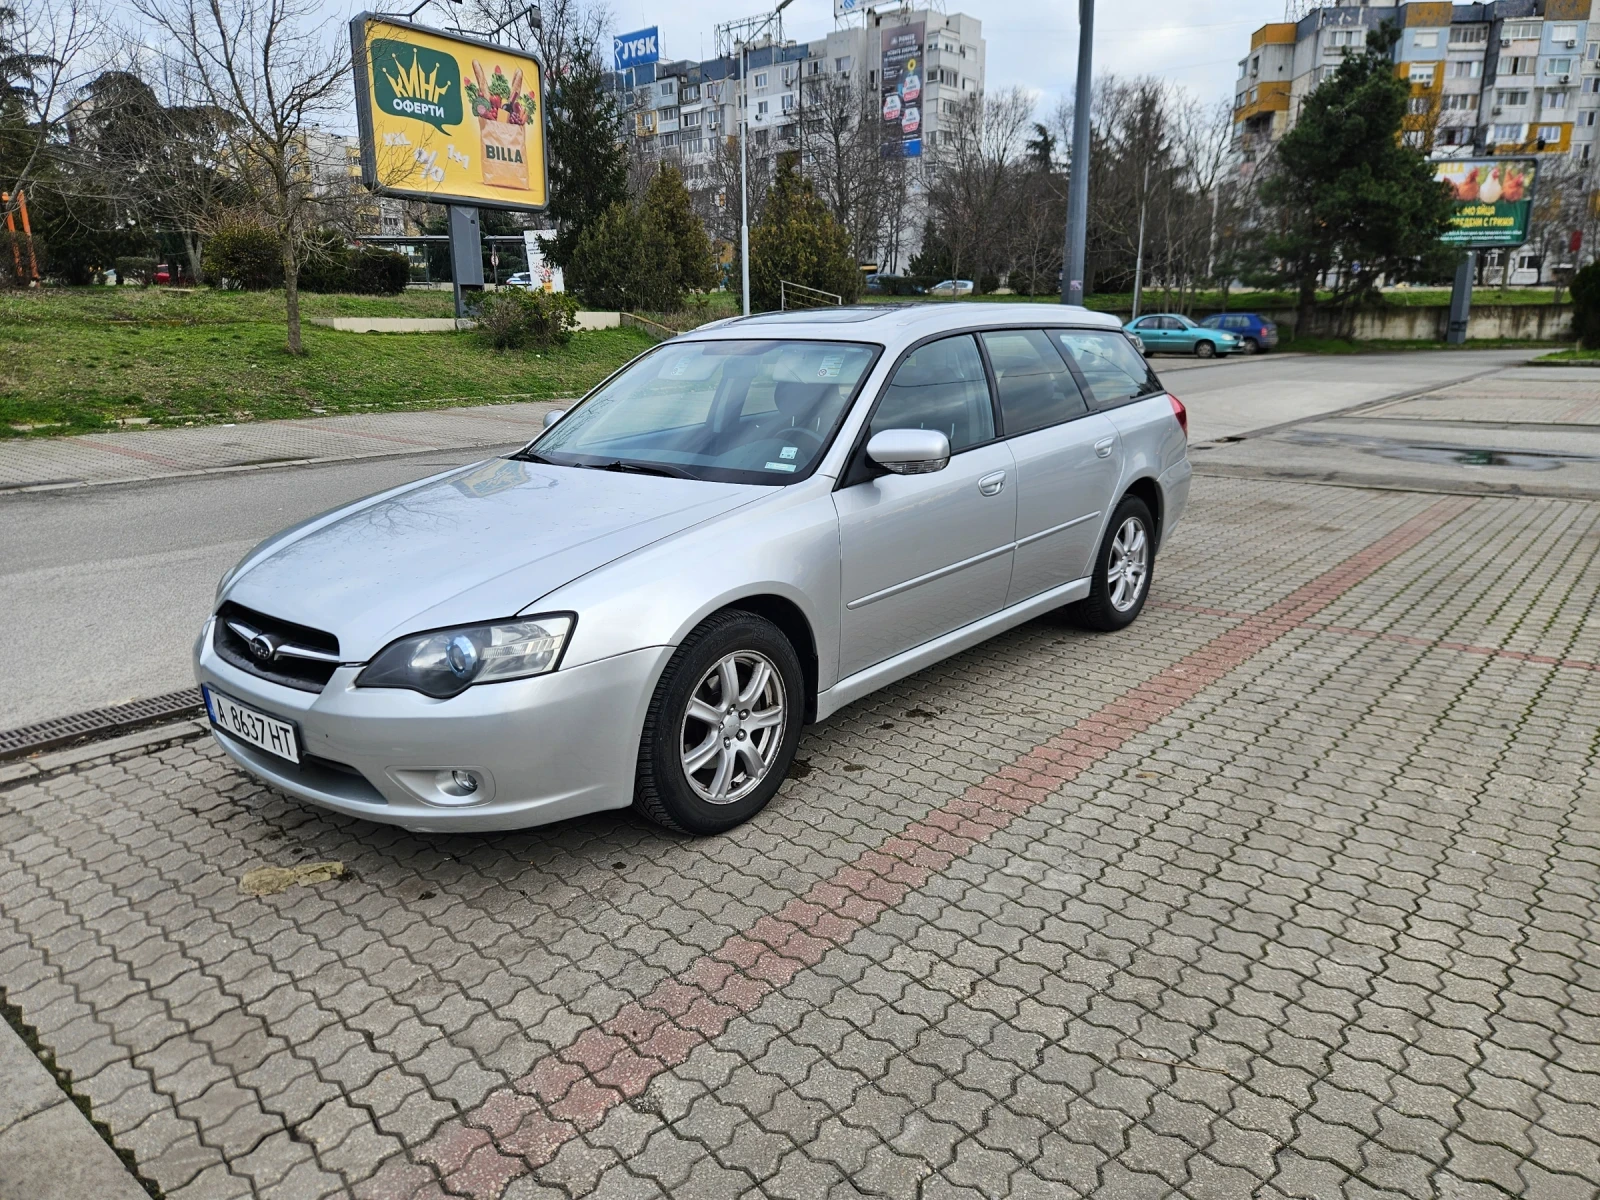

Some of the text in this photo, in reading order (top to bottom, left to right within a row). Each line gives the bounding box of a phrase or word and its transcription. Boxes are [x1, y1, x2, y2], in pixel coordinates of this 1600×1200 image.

[622, 35, 656, 60] JYSK
[383, 48, 451, 103] КИНГ
[393, 98, 444, 118] ОФЕРТИ
[485, 144, 523, 164] BILLA
[216, 698, 291, 757] A 8637 HT
